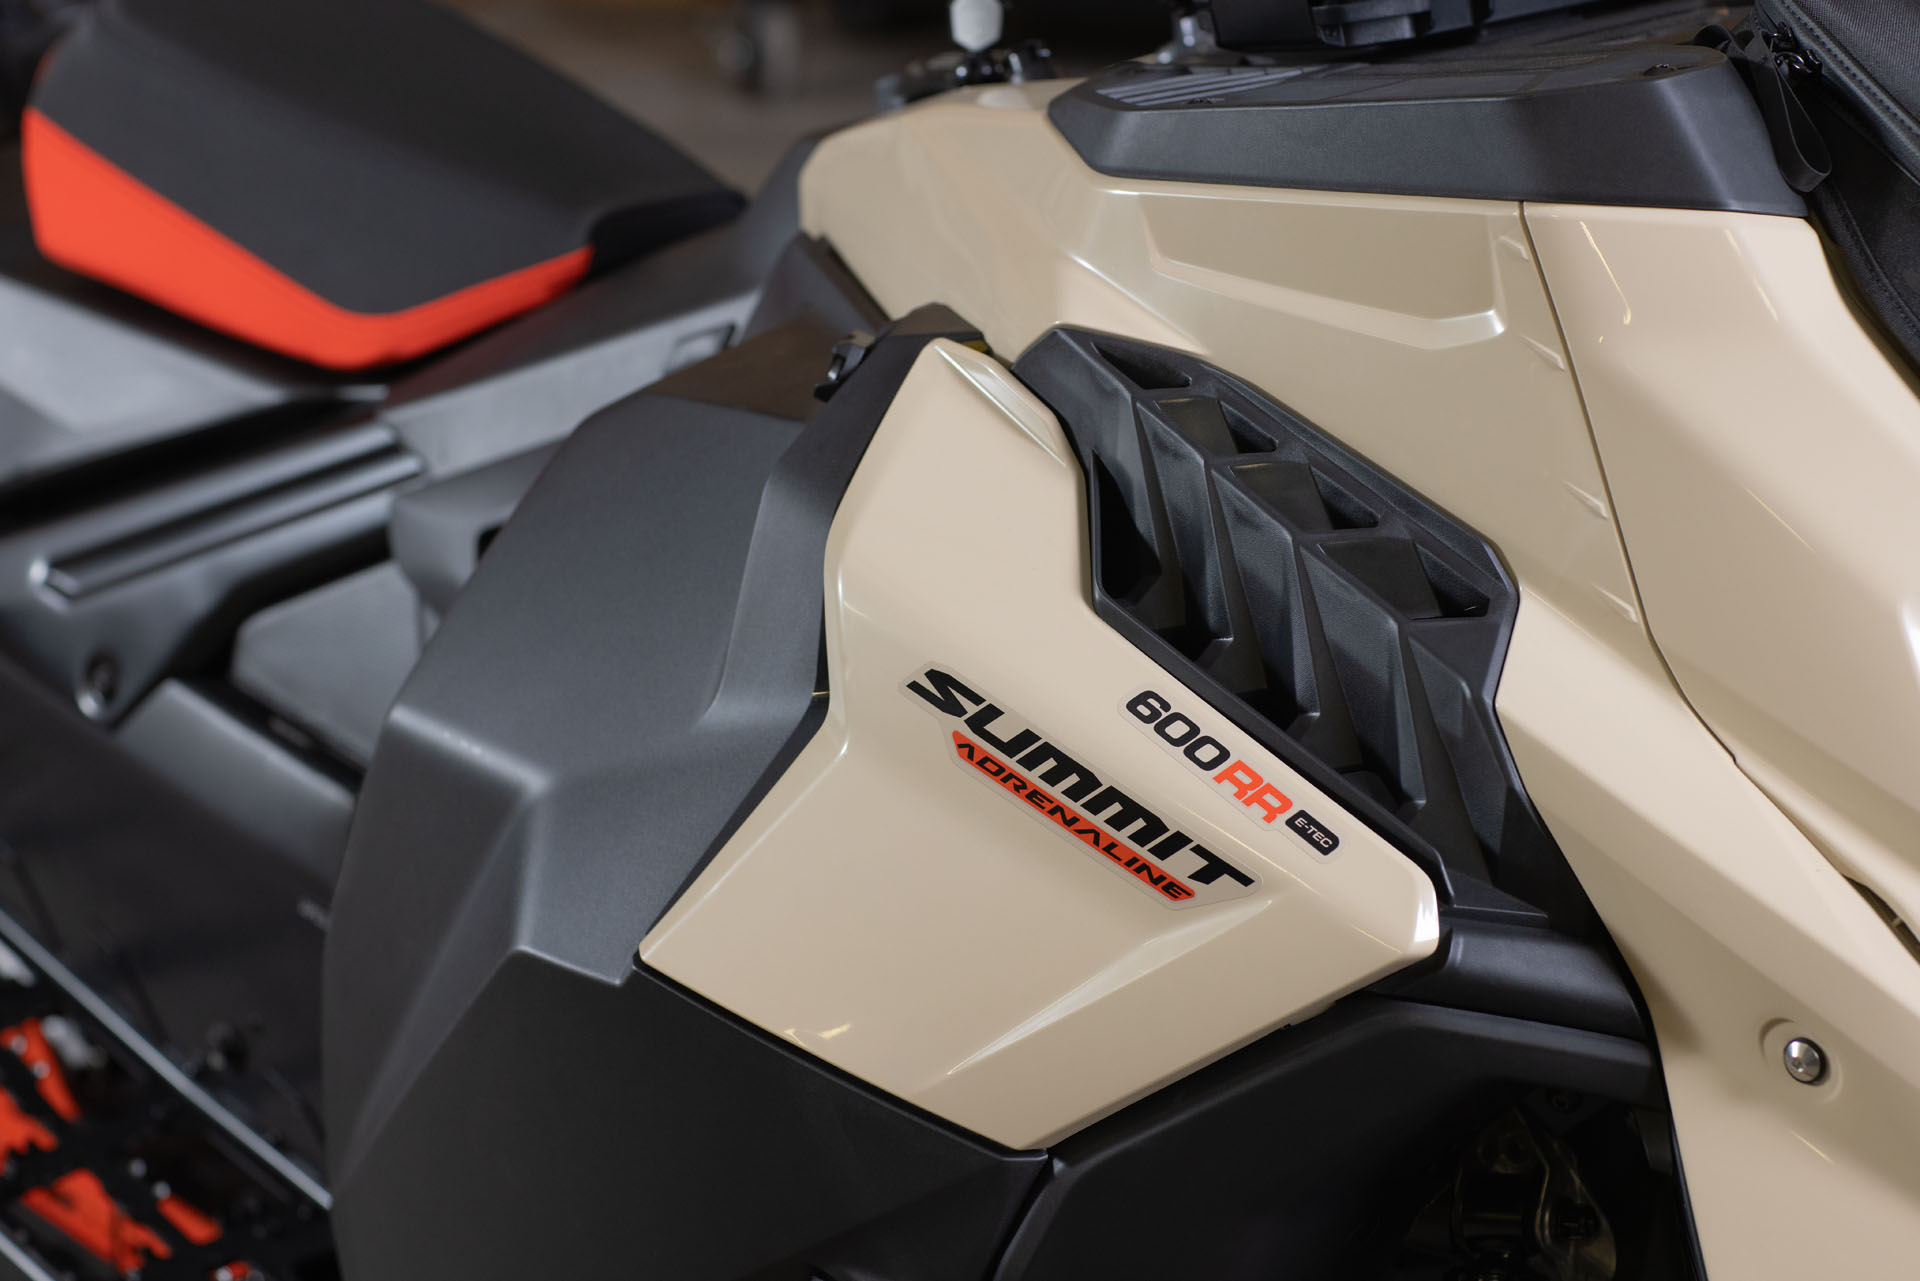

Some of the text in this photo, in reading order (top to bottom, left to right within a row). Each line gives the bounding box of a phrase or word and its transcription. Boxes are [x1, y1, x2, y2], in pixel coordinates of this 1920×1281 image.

[906, 668, 1255, 888] SUMMIT
[956, 743, 1193, 900] ADRENALINE
[1294, 817, 1333, 848] E-TEC
